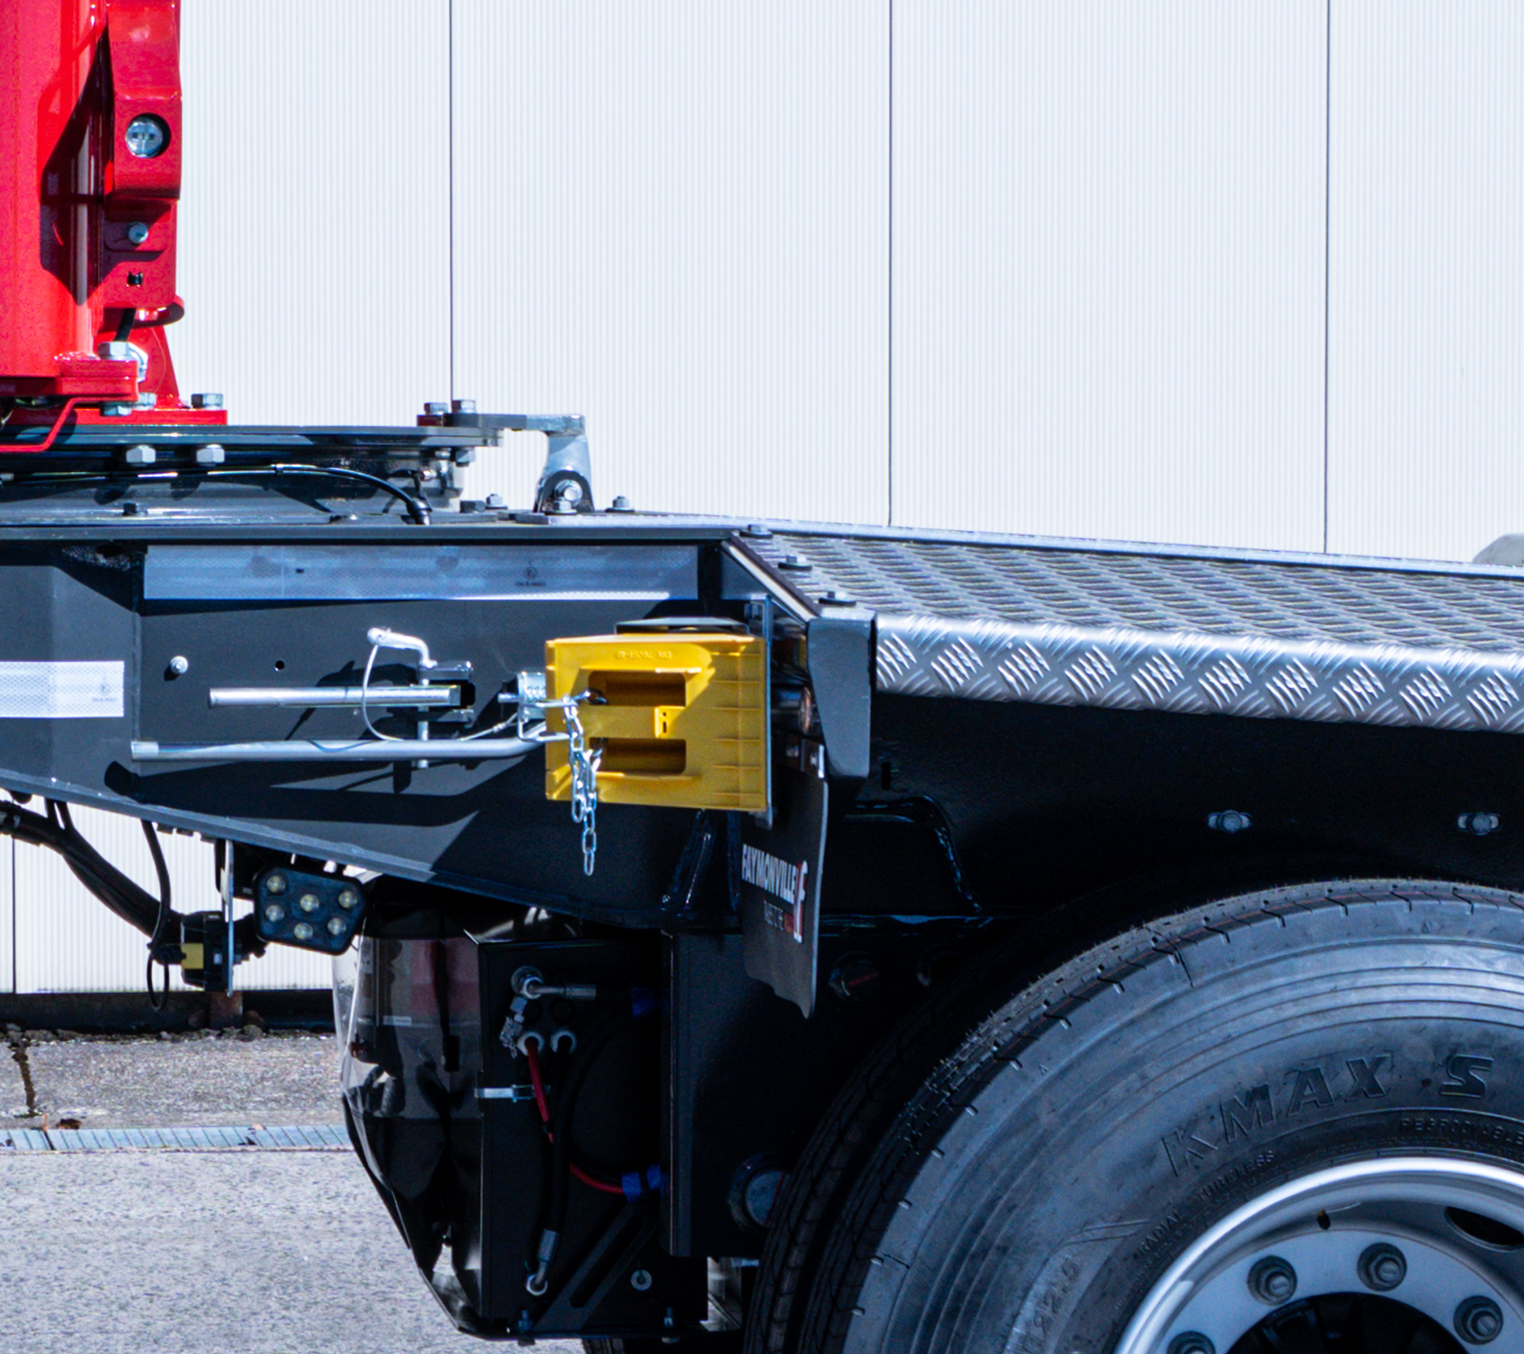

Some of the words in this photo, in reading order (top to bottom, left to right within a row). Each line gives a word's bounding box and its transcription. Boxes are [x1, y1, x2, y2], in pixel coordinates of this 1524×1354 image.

[742, 843, 795, 905] FAYMONVILLE
[1156, 1054, 1391, 1176] KMAX
[1440, 1053, 1494, 1099] S
